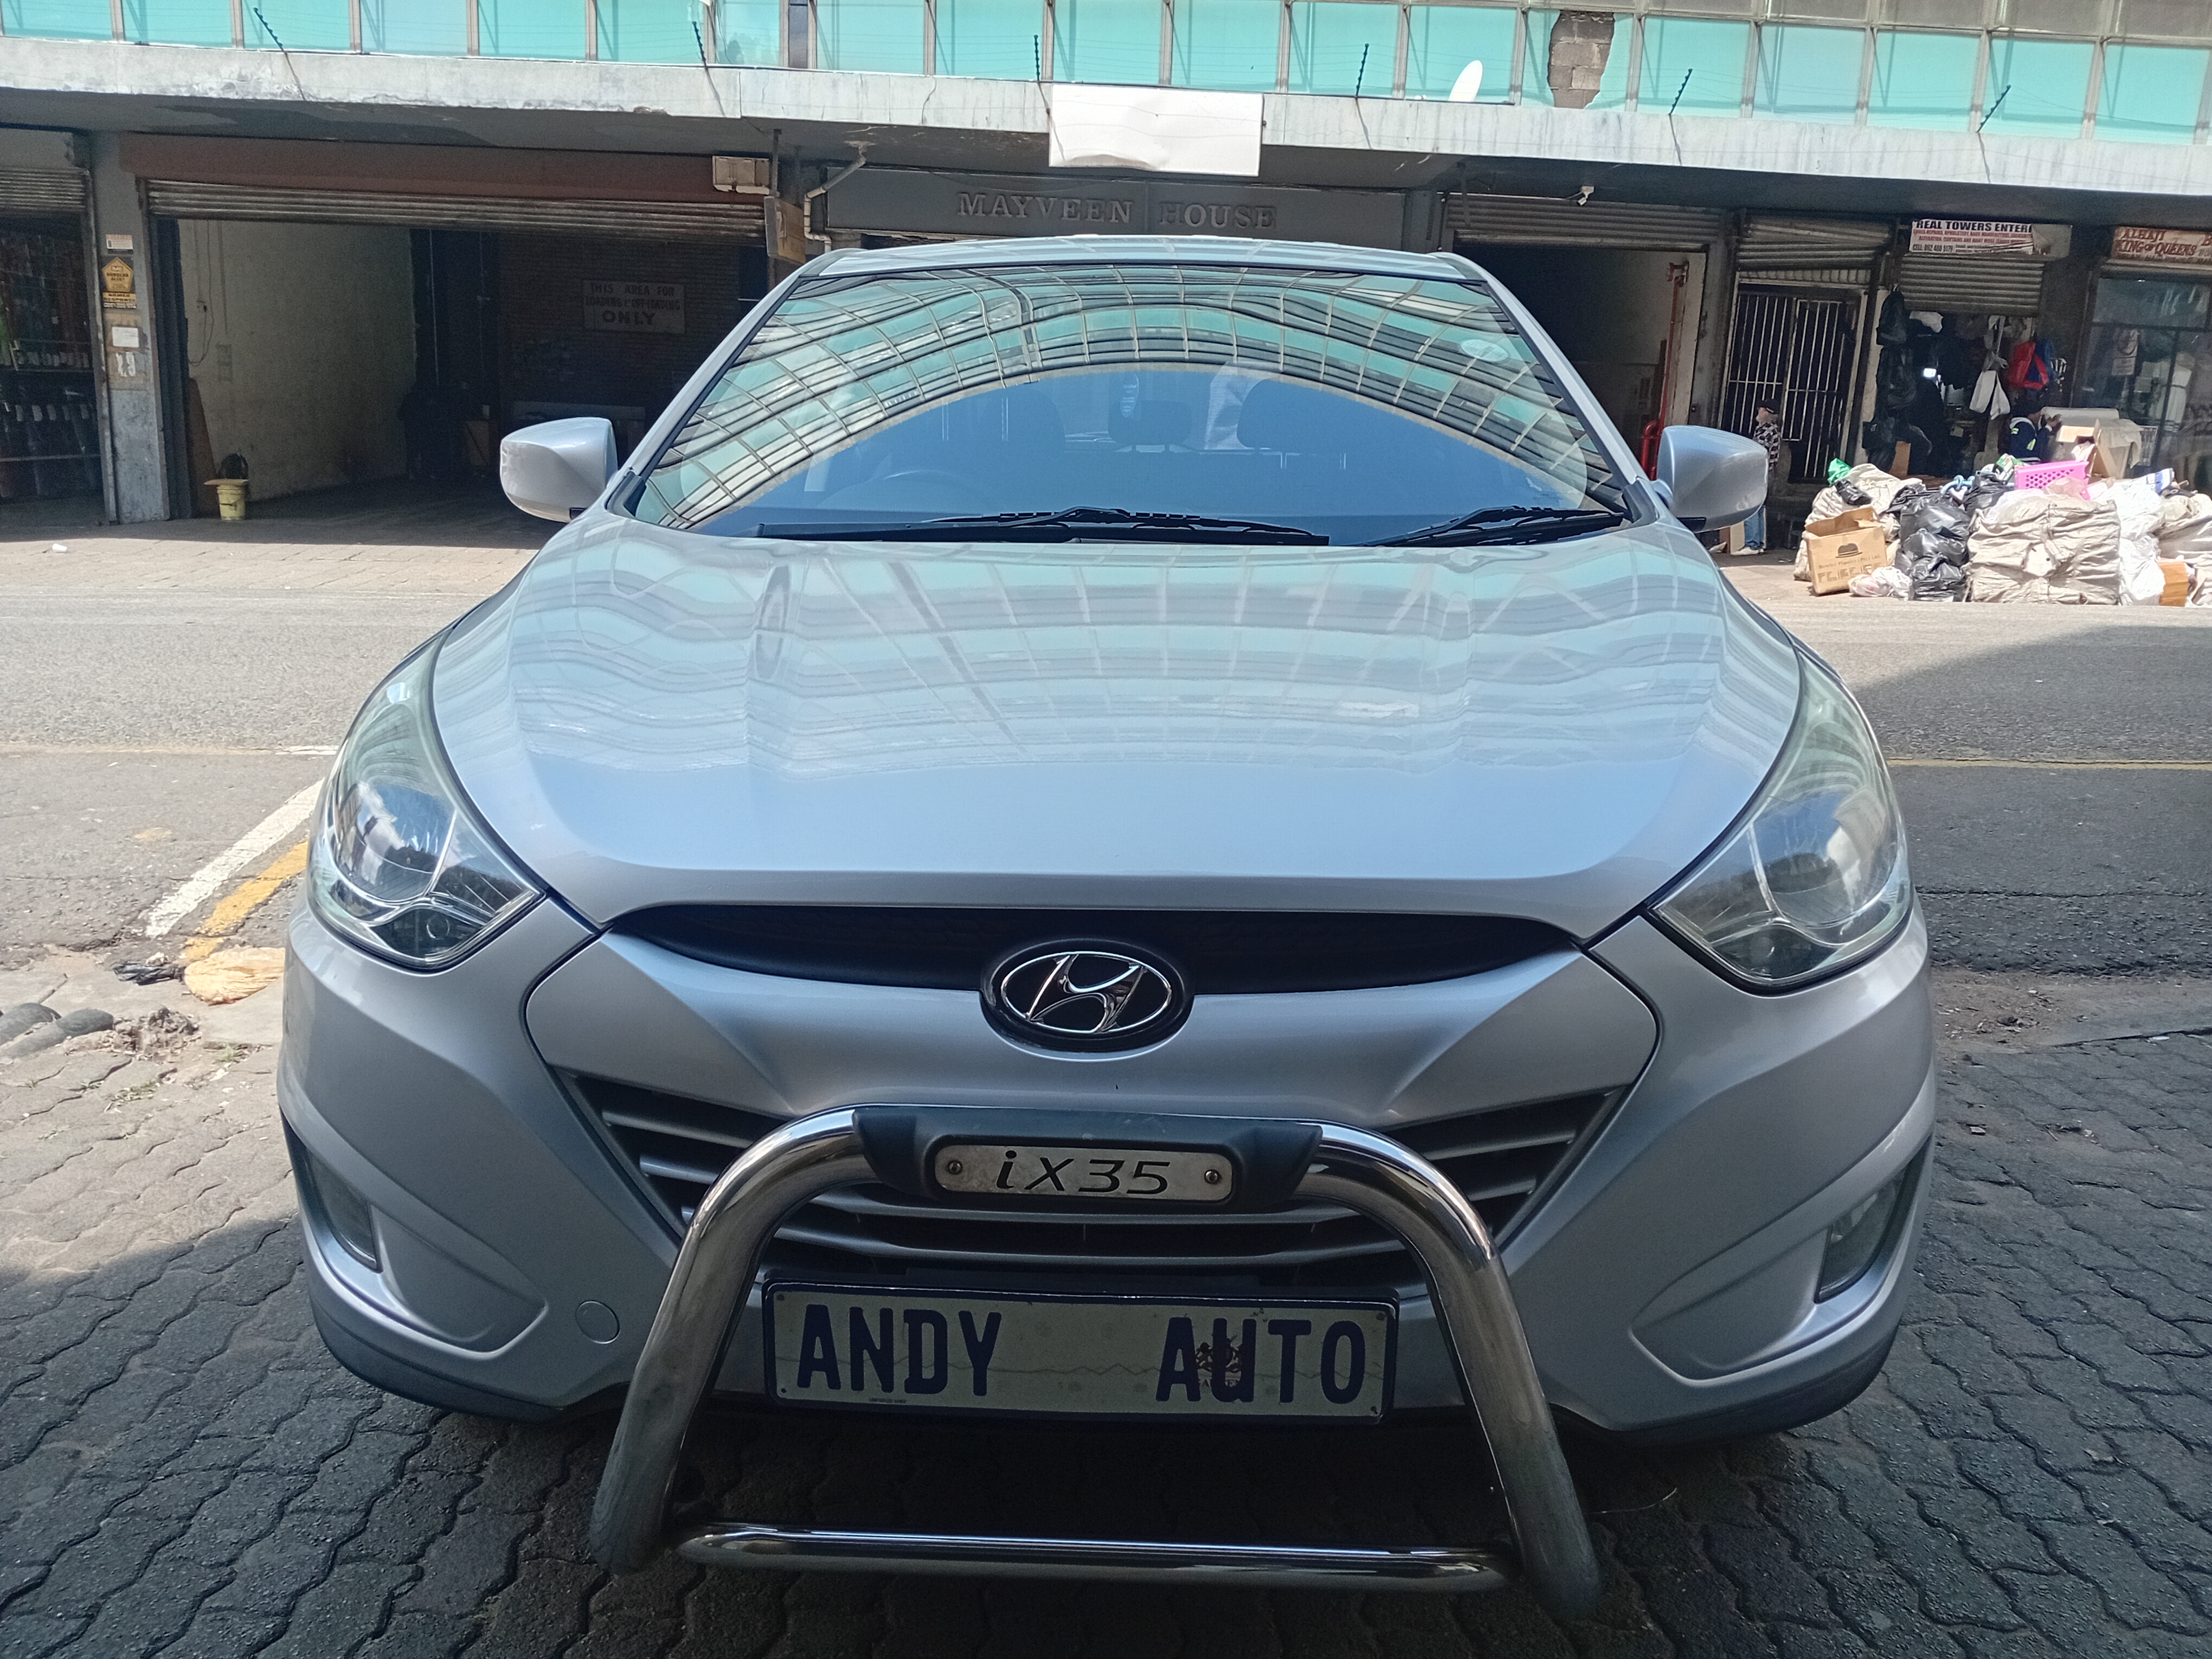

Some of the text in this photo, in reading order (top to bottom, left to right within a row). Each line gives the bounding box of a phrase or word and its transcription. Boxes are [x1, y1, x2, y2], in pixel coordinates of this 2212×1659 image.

[957, 192, 1276, 228] MAYVEEN HOUSE
[1916, 220, 1942, 229] REAL
[1946, 221, 1992, 232] TOWERS
[590, 282, 675, 297] THIS AREA FOR
[602, 310, 655, 325] ONLY
[797, 1303, 1366, 1404] ANDY AUTO
